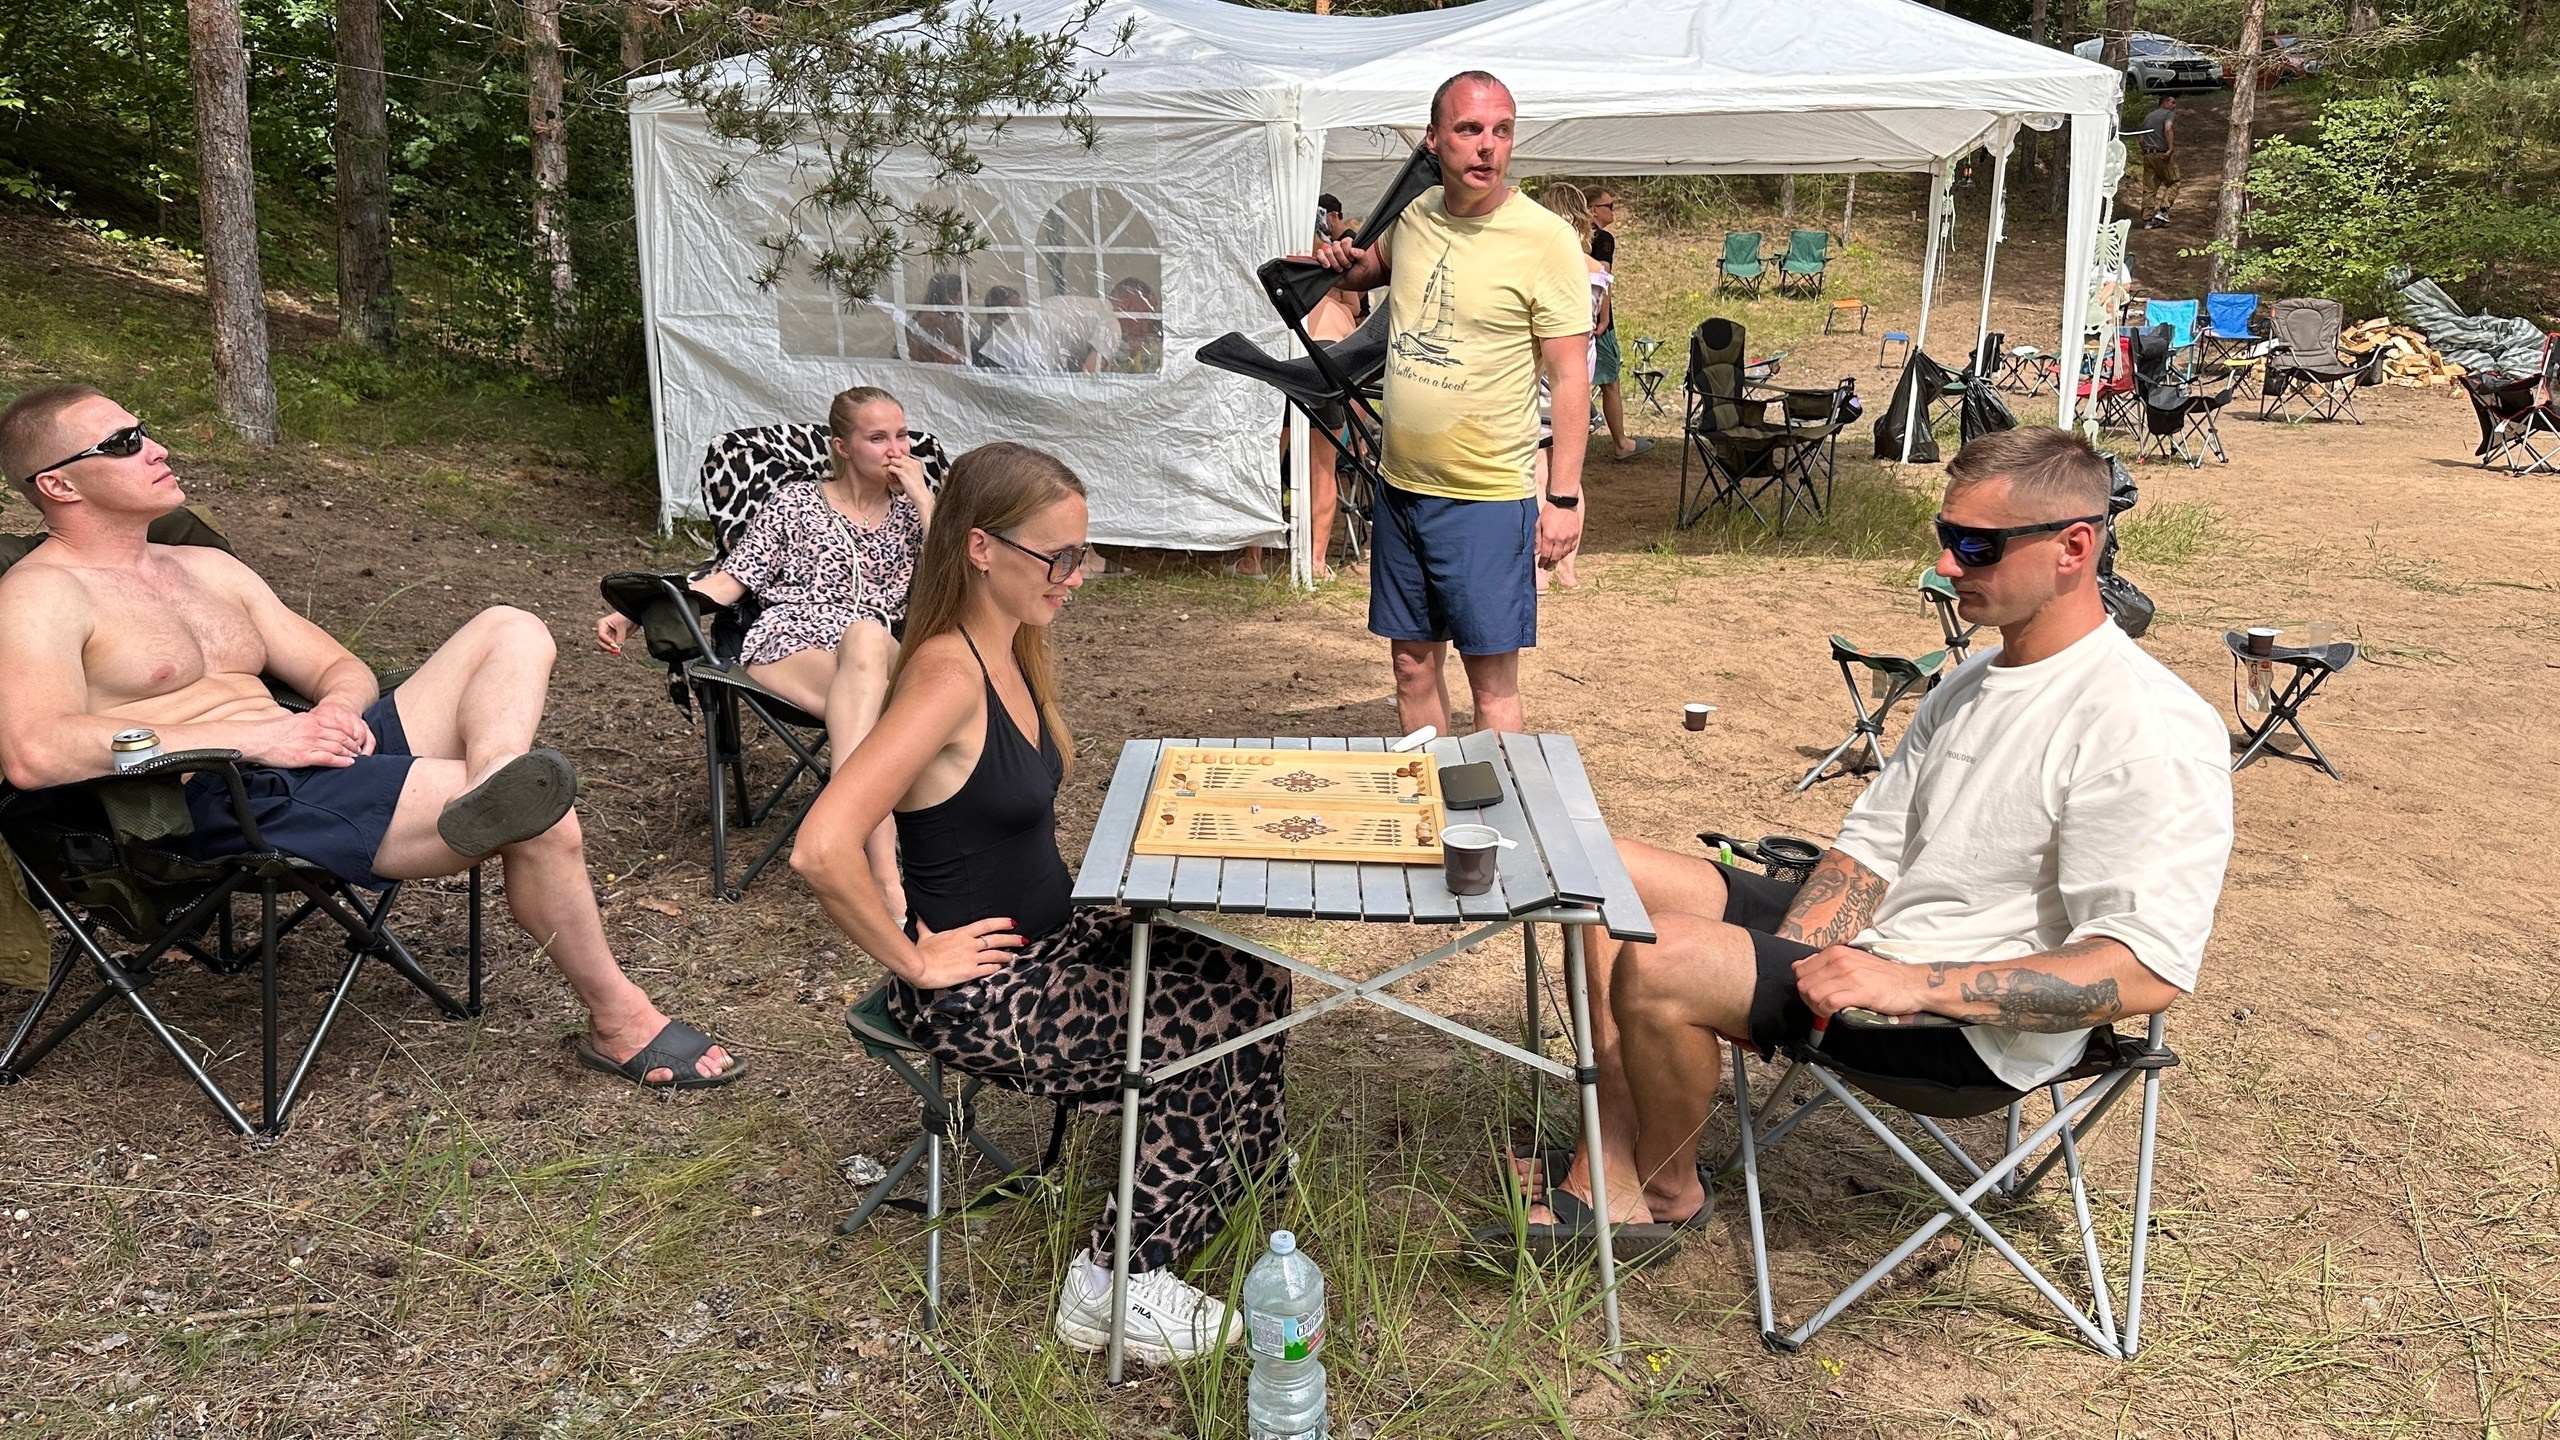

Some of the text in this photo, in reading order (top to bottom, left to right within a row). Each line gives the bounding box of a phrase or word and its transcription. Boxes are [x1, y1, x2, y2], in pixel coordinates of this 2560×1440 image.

[1395, 362, 1418, 381] better
[1418, 375, 1430, 385] on
[1432, 379, 1439, 387] a
[1441, 376, 1468, 392] boat
[1131, 1303, 1152, 1320] FILA
